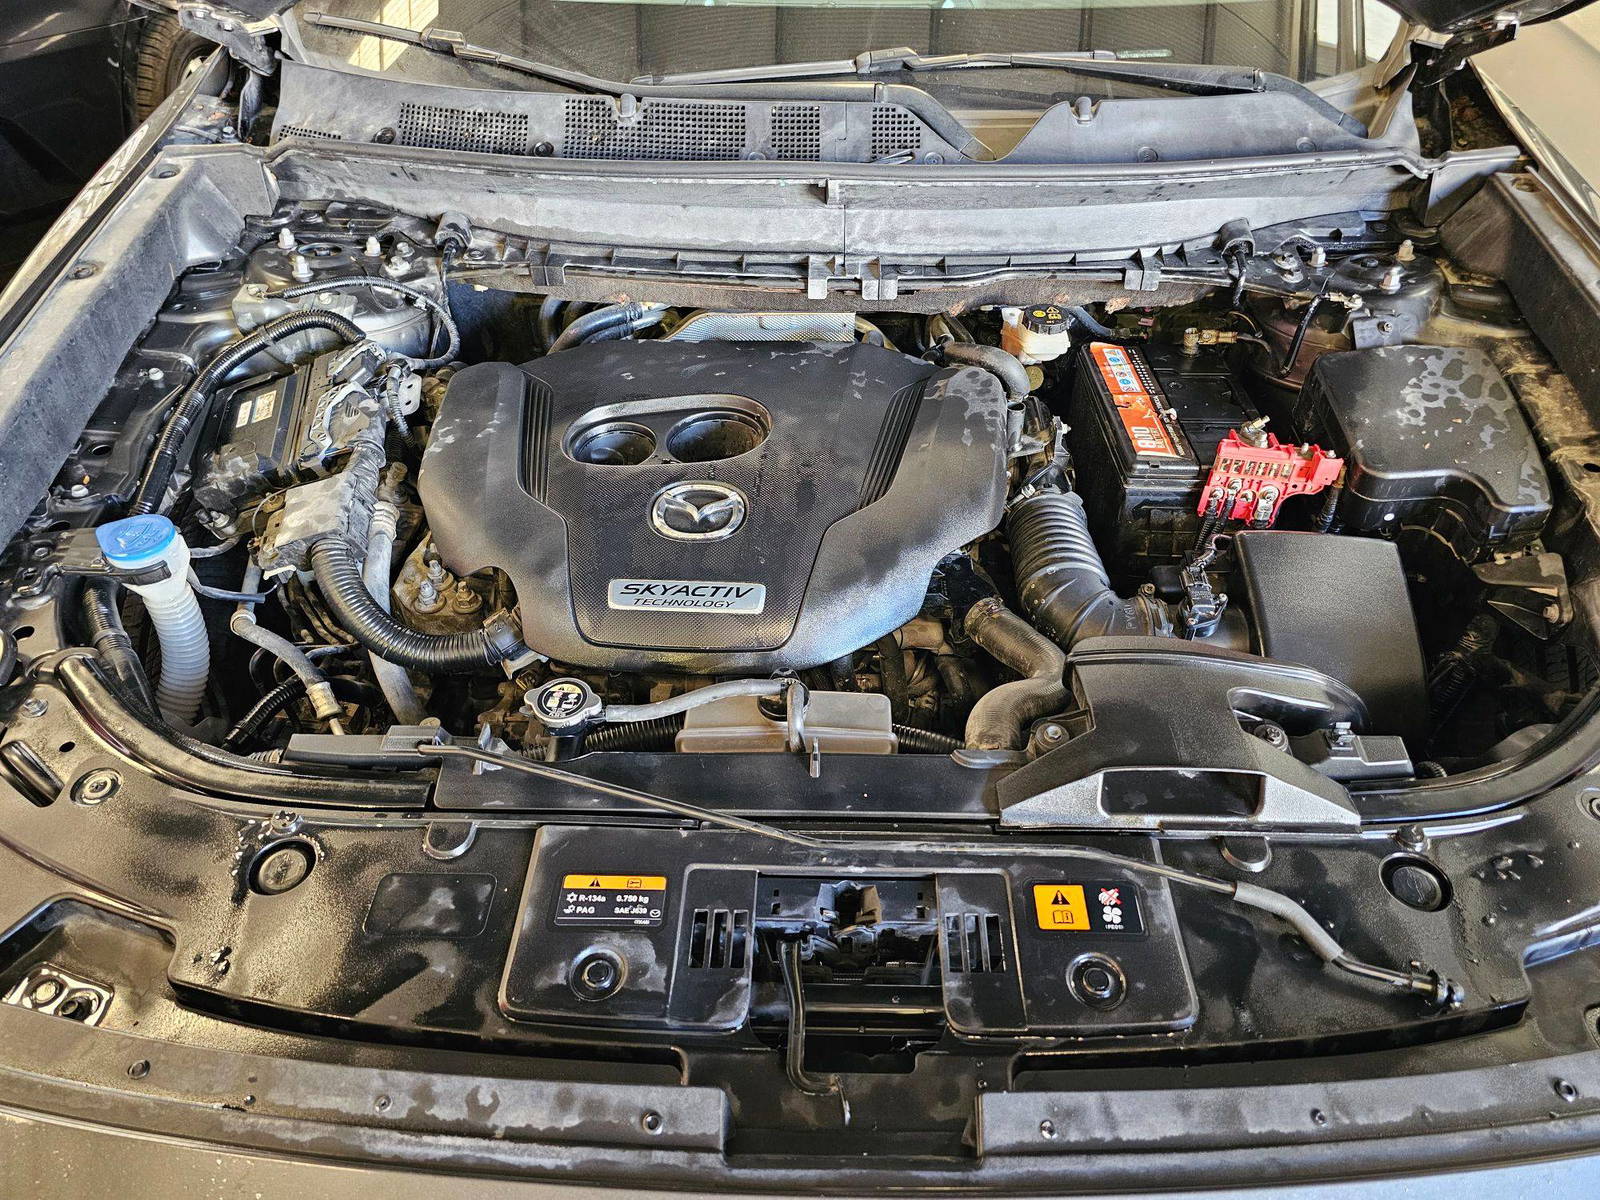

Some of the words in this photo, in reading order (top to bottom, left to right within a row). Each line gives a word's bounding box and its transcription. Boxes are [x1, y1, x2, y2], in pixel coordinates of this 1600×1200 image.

[620, 583, 755, 598] SKYACTIV
[633, 598, 736, 608] TECHNOLOGY
[578, 894, 607, 903] R-134a
[638, 894, 650, 904] kg
[575, 906, 596, 914] PAG
